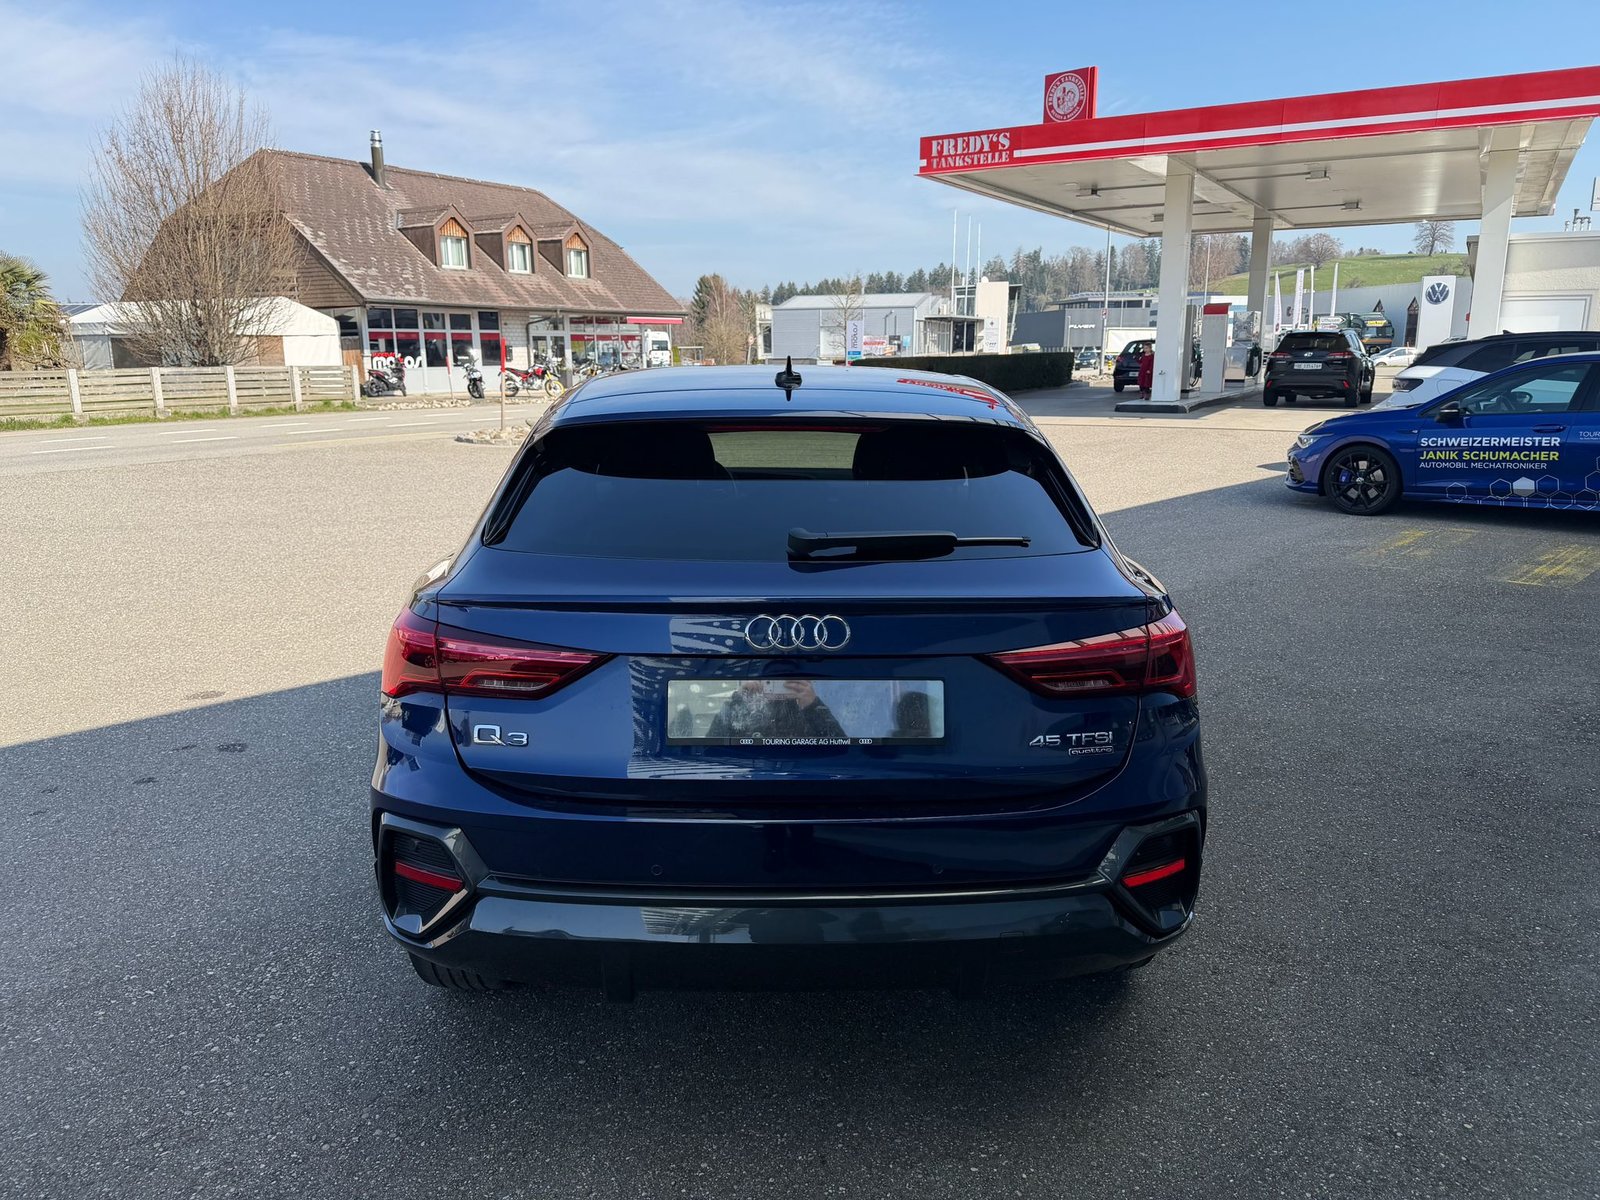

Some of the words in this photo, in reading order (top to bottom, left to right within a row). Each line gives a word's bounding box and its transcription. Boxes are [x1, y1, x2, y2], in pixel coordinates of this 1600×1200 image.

[931, 151, 1009, 169] TANKSTELLE
[1420, 437, 1560, 447] SCHWEIZERMEISTER
[1419, 451, 1458, 460] JANIK
[1462, 451, 1559, 461] SCHUMACHER
[1471, 462, 1547, 470] MECHATRONIKER
[1029, 734, 1061, 747] 45
[1066, 731, 1113, 746] TFSI
[1070, 747, 1113, 755] quattro
